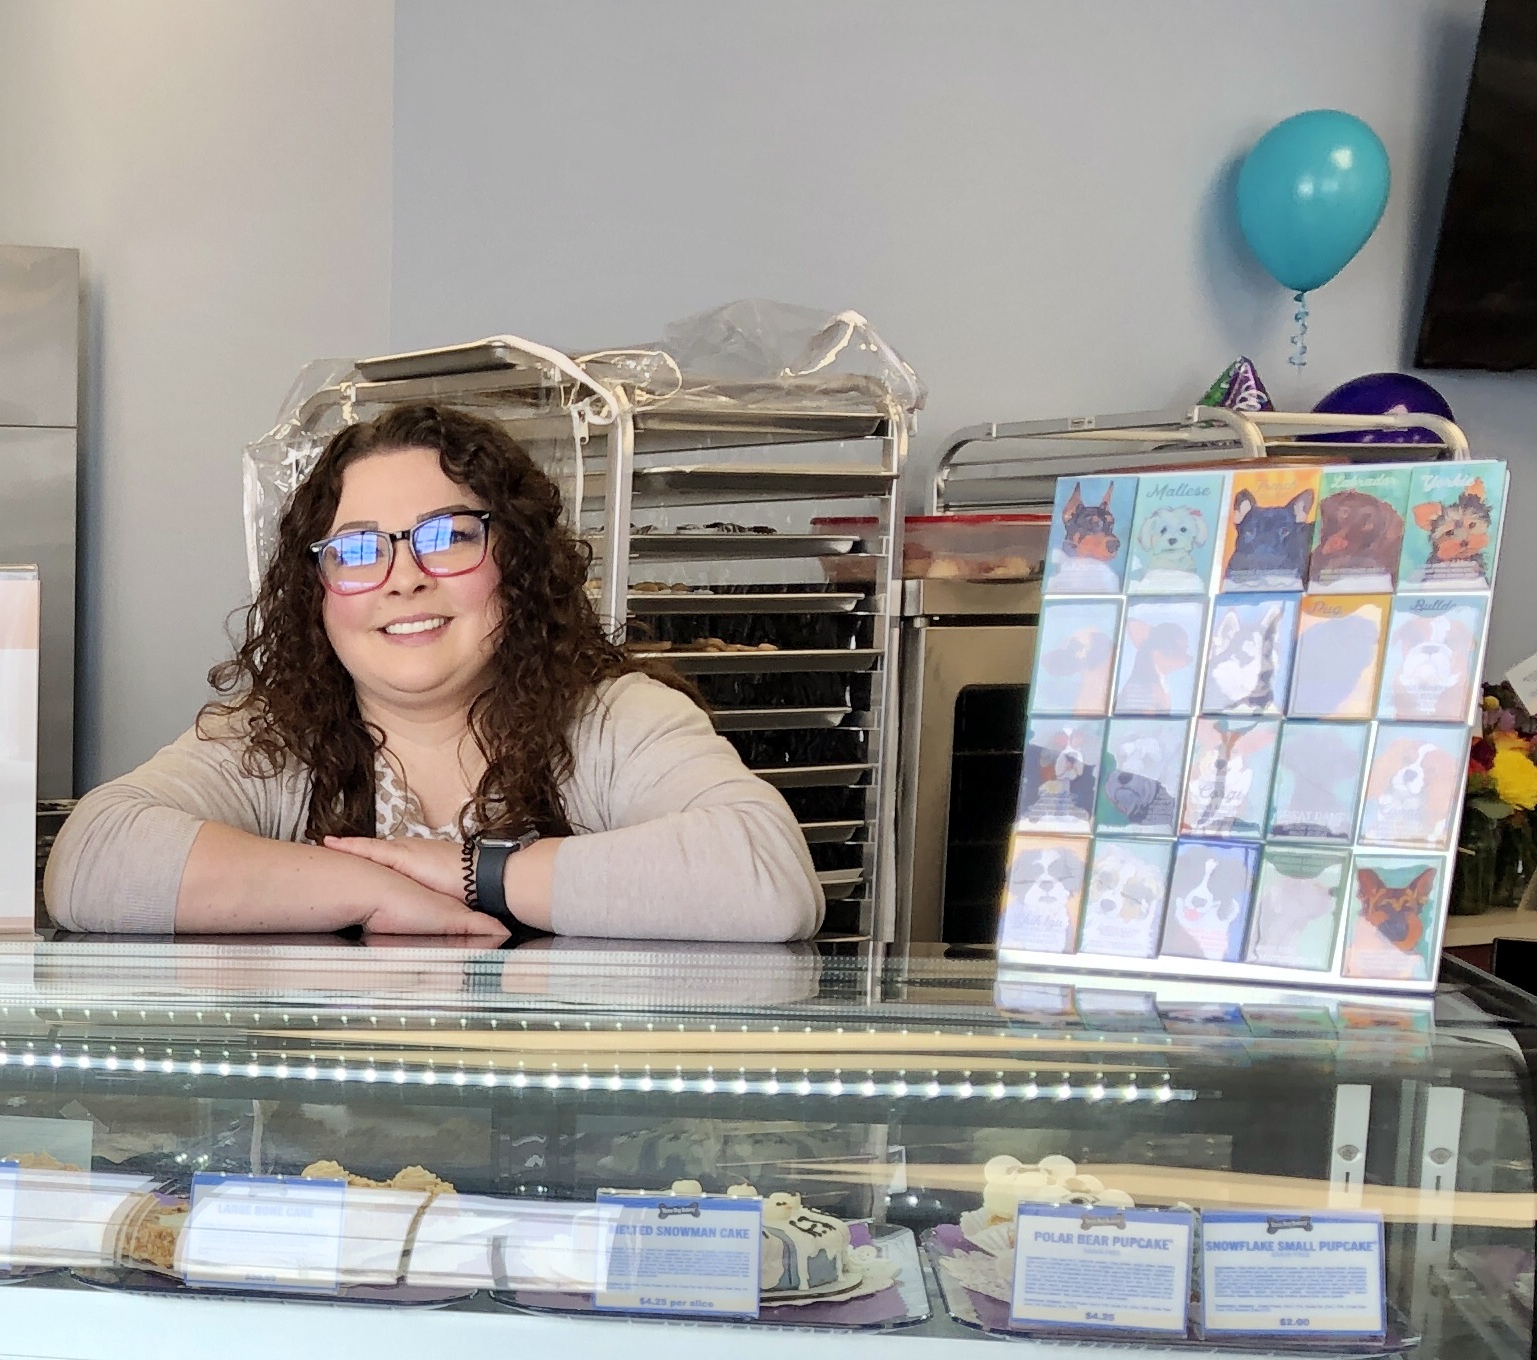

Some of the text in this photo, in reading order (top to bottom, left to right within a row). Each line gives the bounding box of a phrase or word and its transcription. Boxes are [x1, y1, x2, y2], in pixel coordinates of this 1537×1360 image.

[1146, 482, 1212, 500] Maltese
[657, 1225, 716, 1239] SNOWMAN
[720, 1228, 750, 1240] CAKE
[1034, 1231, 1073, 1244] POLAR
[1077, 1234, 1109, 1246] BEAR
[1205, 1241, 1274, 1251] SNOWFLAKE
[1278, 1241, 1316, 1251] SMALL
[670, 1299, 686, 1308] per
[690, 1298, 714, 1308] slice
